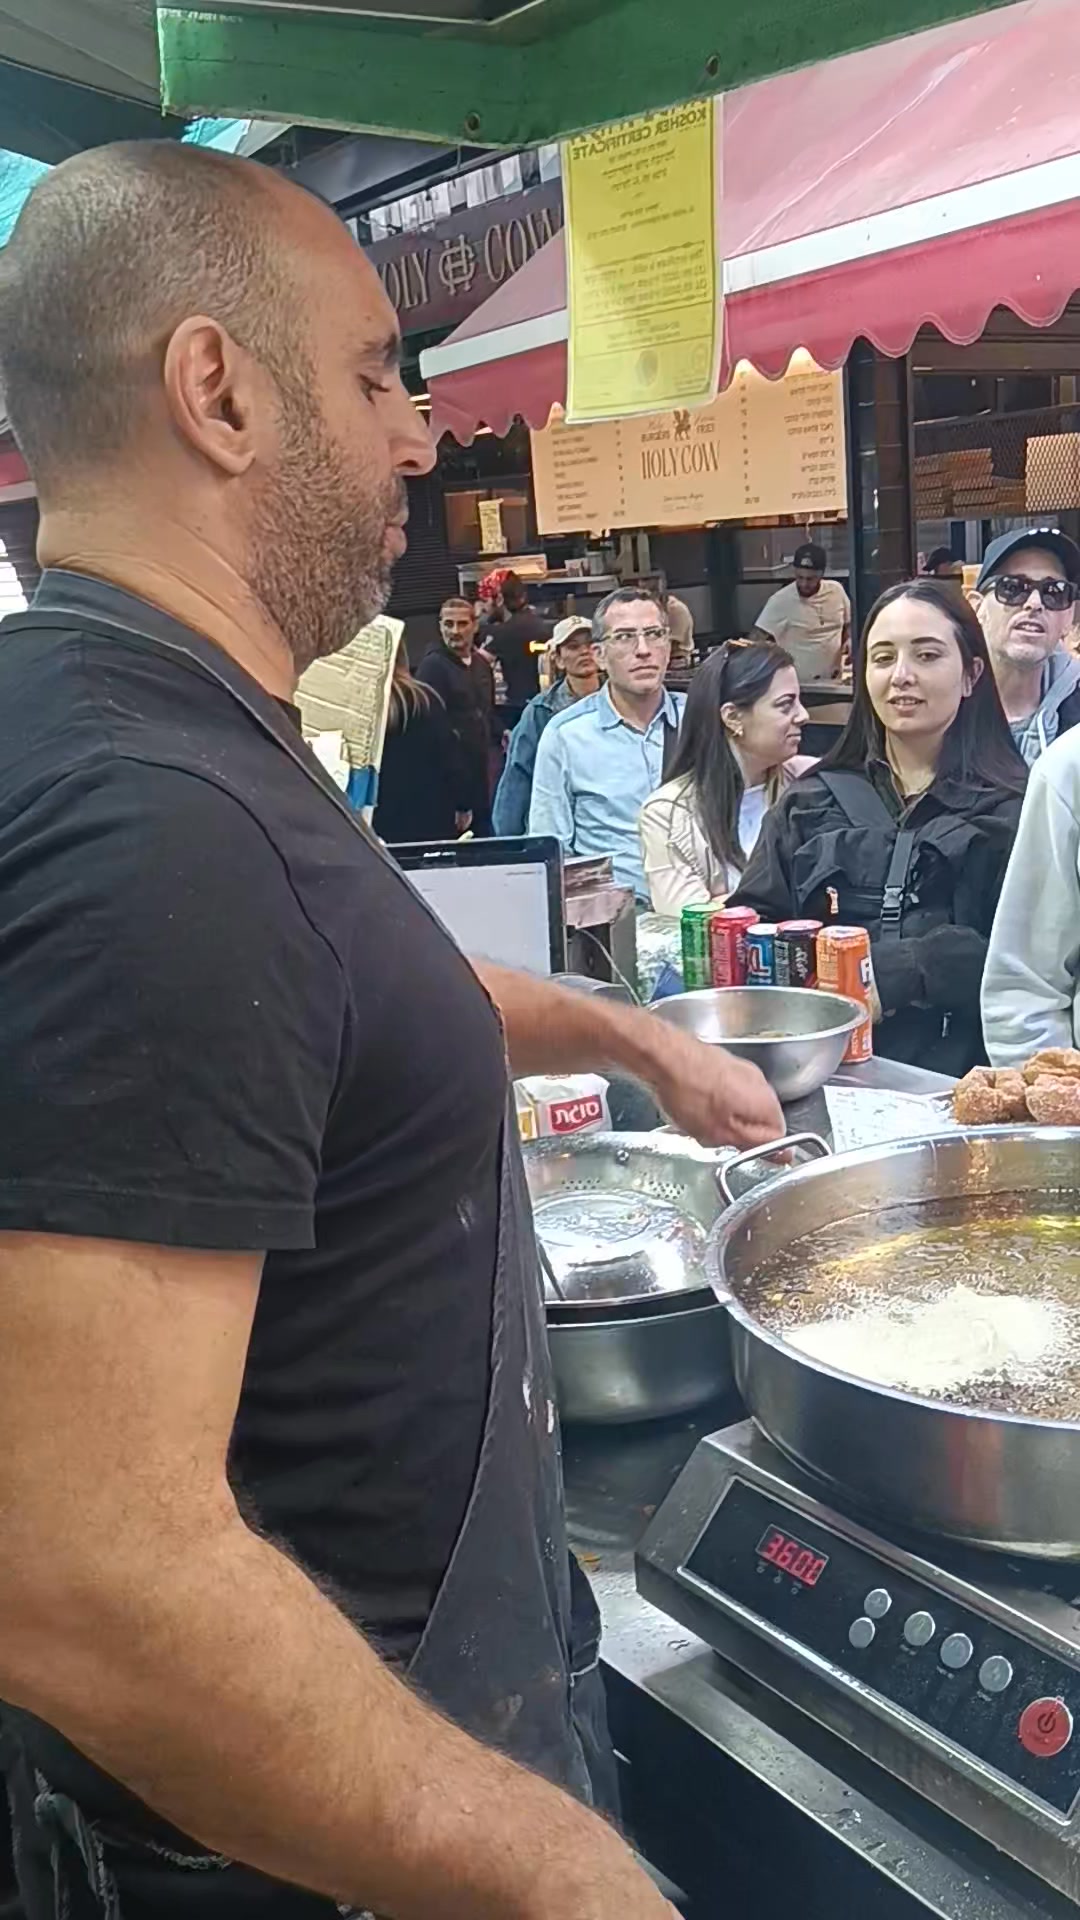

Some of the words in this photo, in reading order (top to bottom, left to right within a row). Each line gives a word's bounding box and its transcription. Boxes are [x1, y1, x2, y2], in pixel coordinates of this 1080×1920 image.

[379, 248, 431, 311] OLY
[641, 447, 679, 480] HOLY
[554, 1101, 600, 1125] סוגת
